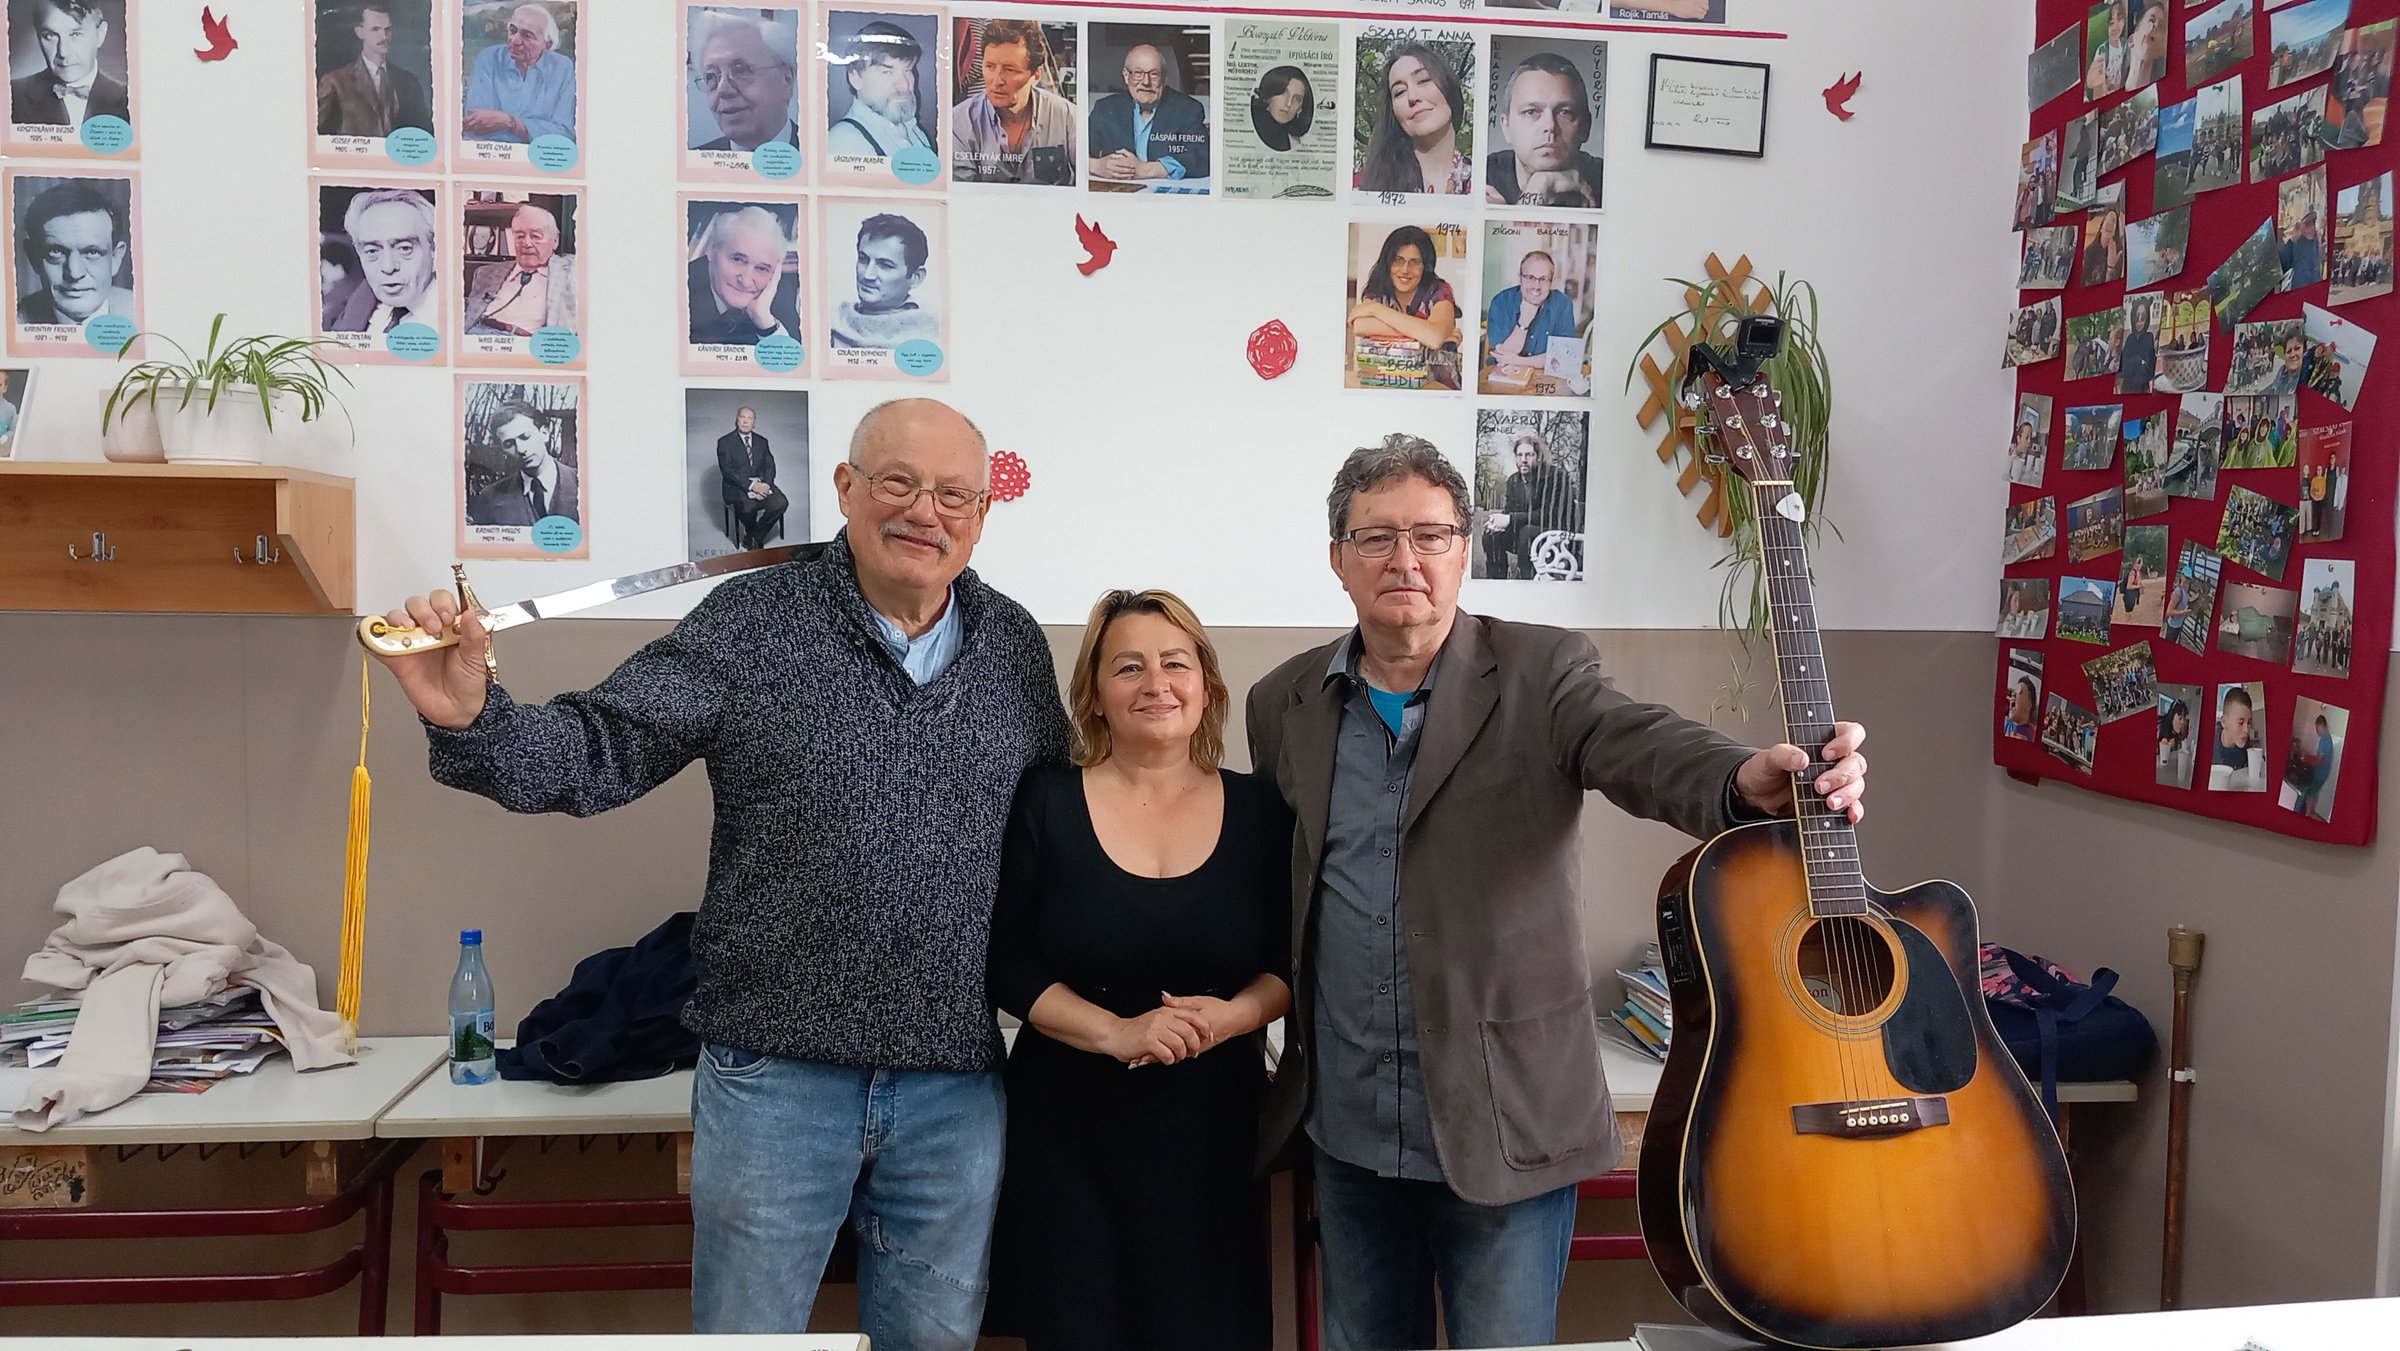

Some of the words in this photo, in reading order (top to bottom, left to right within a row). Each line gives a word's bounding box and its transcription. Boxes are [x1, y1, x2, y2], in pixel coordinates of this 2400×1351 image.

[1641, 10, 1669, 20] Tamás
[1362, 25, 1417, 39] SZABÓ
[1437, 29, 1473, 41] ANNA
[1320, 50, 1333, 60] ÍRÓ
[1150, 132, 1177, 142] GÁSPÁR
[1178, 134, 1205, 143] FERENC
[1168, 145, 1188, 153] 1957-
[954, 151, 1001, 161] CSELENYÁK
[1002, 153, 1024, 163] IMRE
[978, 165, 1000, 175] 1957-
[1378, 191, 1406, 206] 1972
[1519, 192, 1545, 206] 1973
[1535, 383, 1556, 394] 1975
